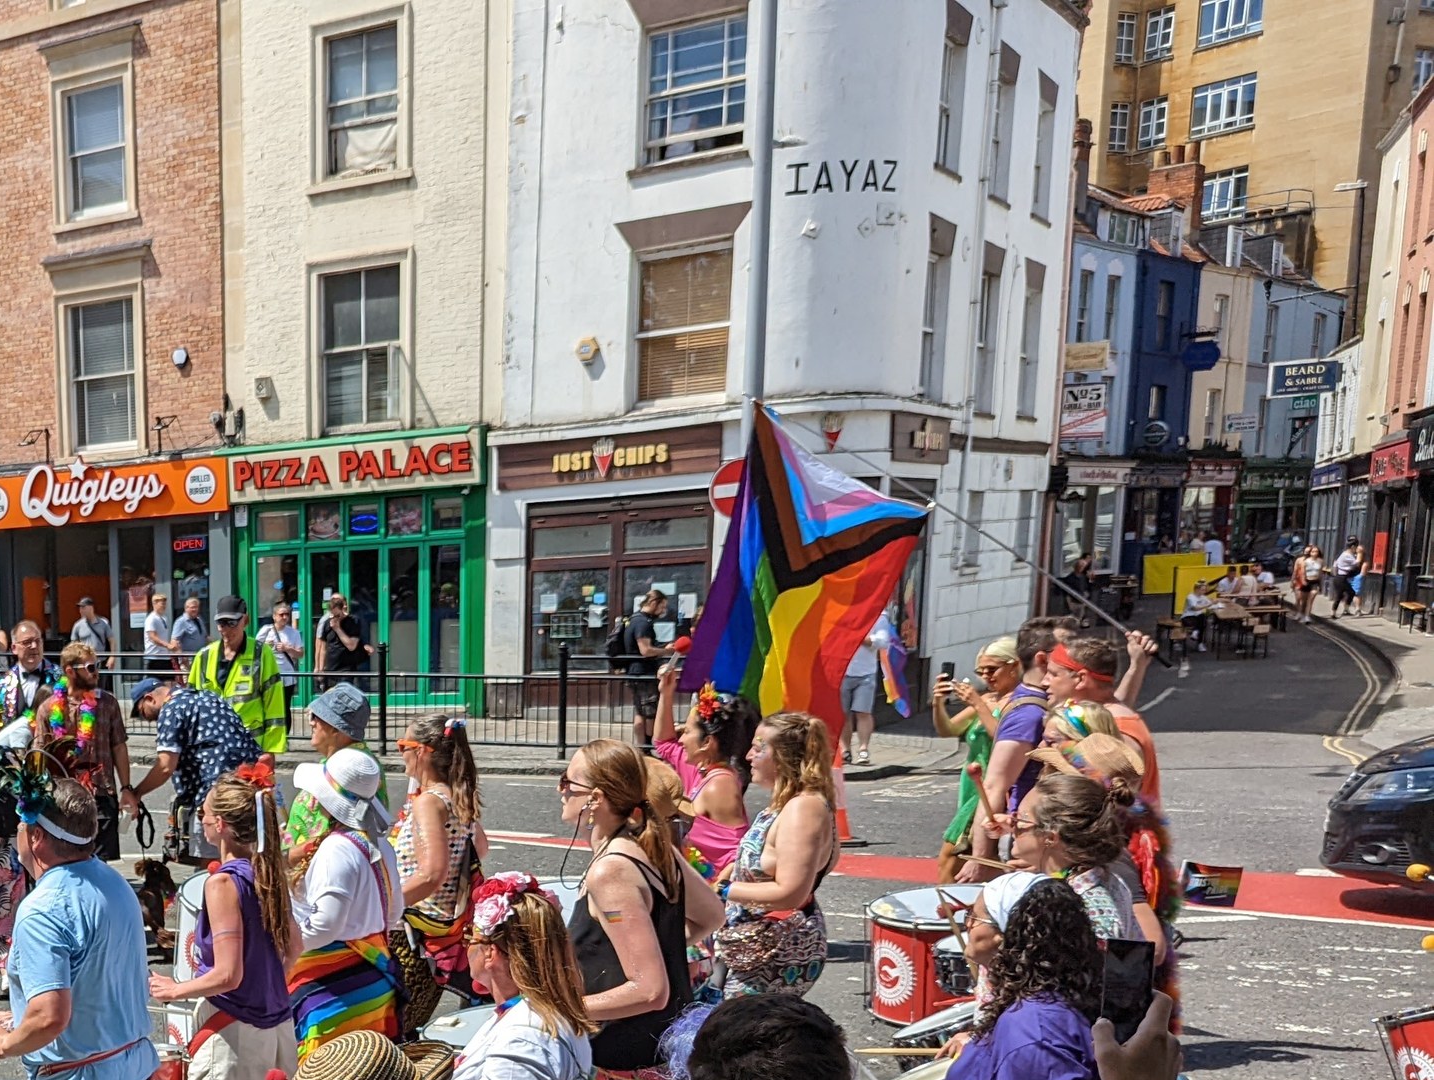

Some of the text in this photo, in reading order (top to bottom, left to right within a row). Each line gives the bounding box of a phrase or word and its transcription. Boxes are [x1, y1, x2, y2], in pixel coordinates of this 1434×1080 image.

[785, 160, 897, 196] IAYAZ
[1285, 364, 1326, 376] BEARD
[1285, 377, 1323, 386] & SABRE
[1293, 396, 1316, 409] ciao
[552, 443, 668, 473] JUST CHIPS
[233, 441, 472, 491] PIZZA PALACE
[189, 474, 211, 484] GRILLED
[21, 465, 165, 526] Quigleys
[188, 486, 212, 496] BURGERS
[173, 539, 204, 551] OPEN
